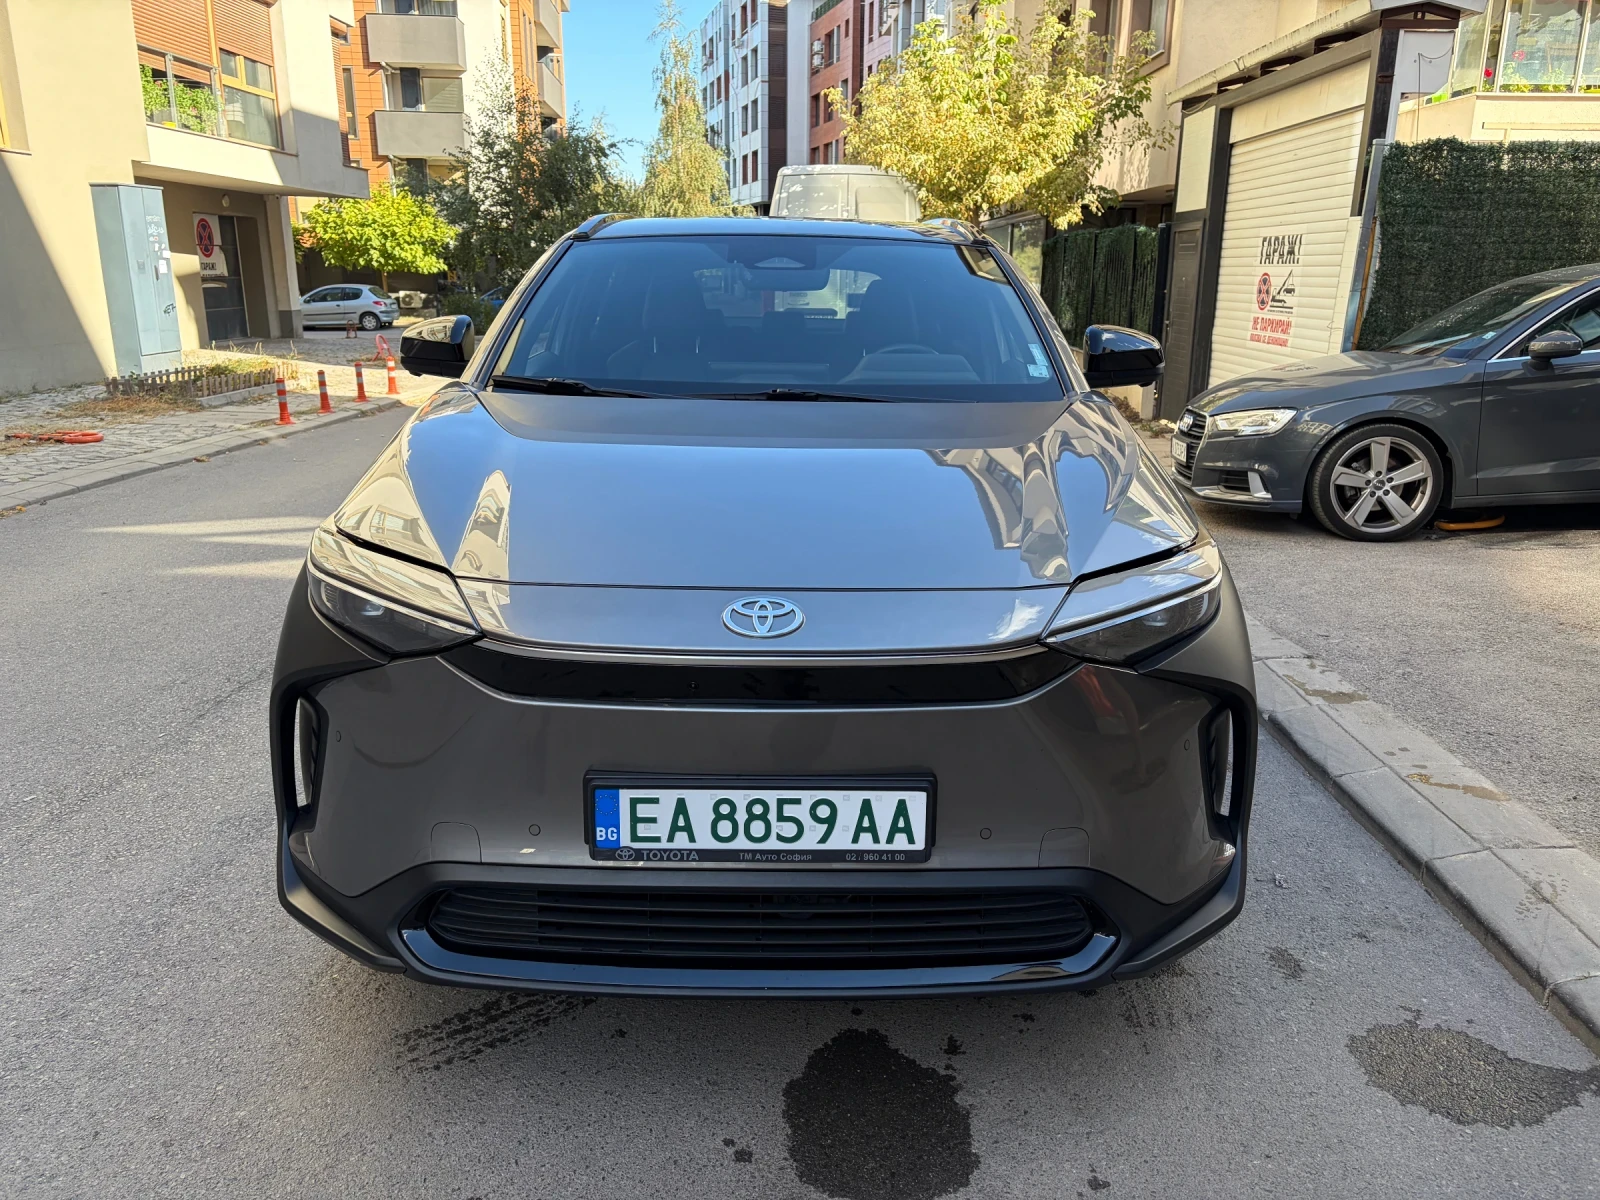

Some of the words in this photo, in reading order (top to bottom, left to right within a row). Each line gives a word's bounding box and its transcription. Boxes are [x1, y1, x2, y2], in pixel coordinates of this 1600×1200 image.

[1260, 234, 1303, 264] ГАРАЖ!
[1252, 316, 1260, 330] НЕ
[1260, 317, 1292, 335] ПАРКИРАЙ!
[629, 796, 697, 843] EA
[711, 797, 838, 844] 8859
[851, 798, 916, 845] AA
[596, 827, 618, 841] BG
[641, 850, 699, 861] TOYOTA
[739, 852, 753, 861] ТМ
[755, 852, 778, 862] Ауто
[780, 852, 812, 862] София
[845, 853, 857, 861] 02
[863, 853, 880, 861] 960
[881, 853, 893, 861] 41
[894, 853, 906, 861] 00
